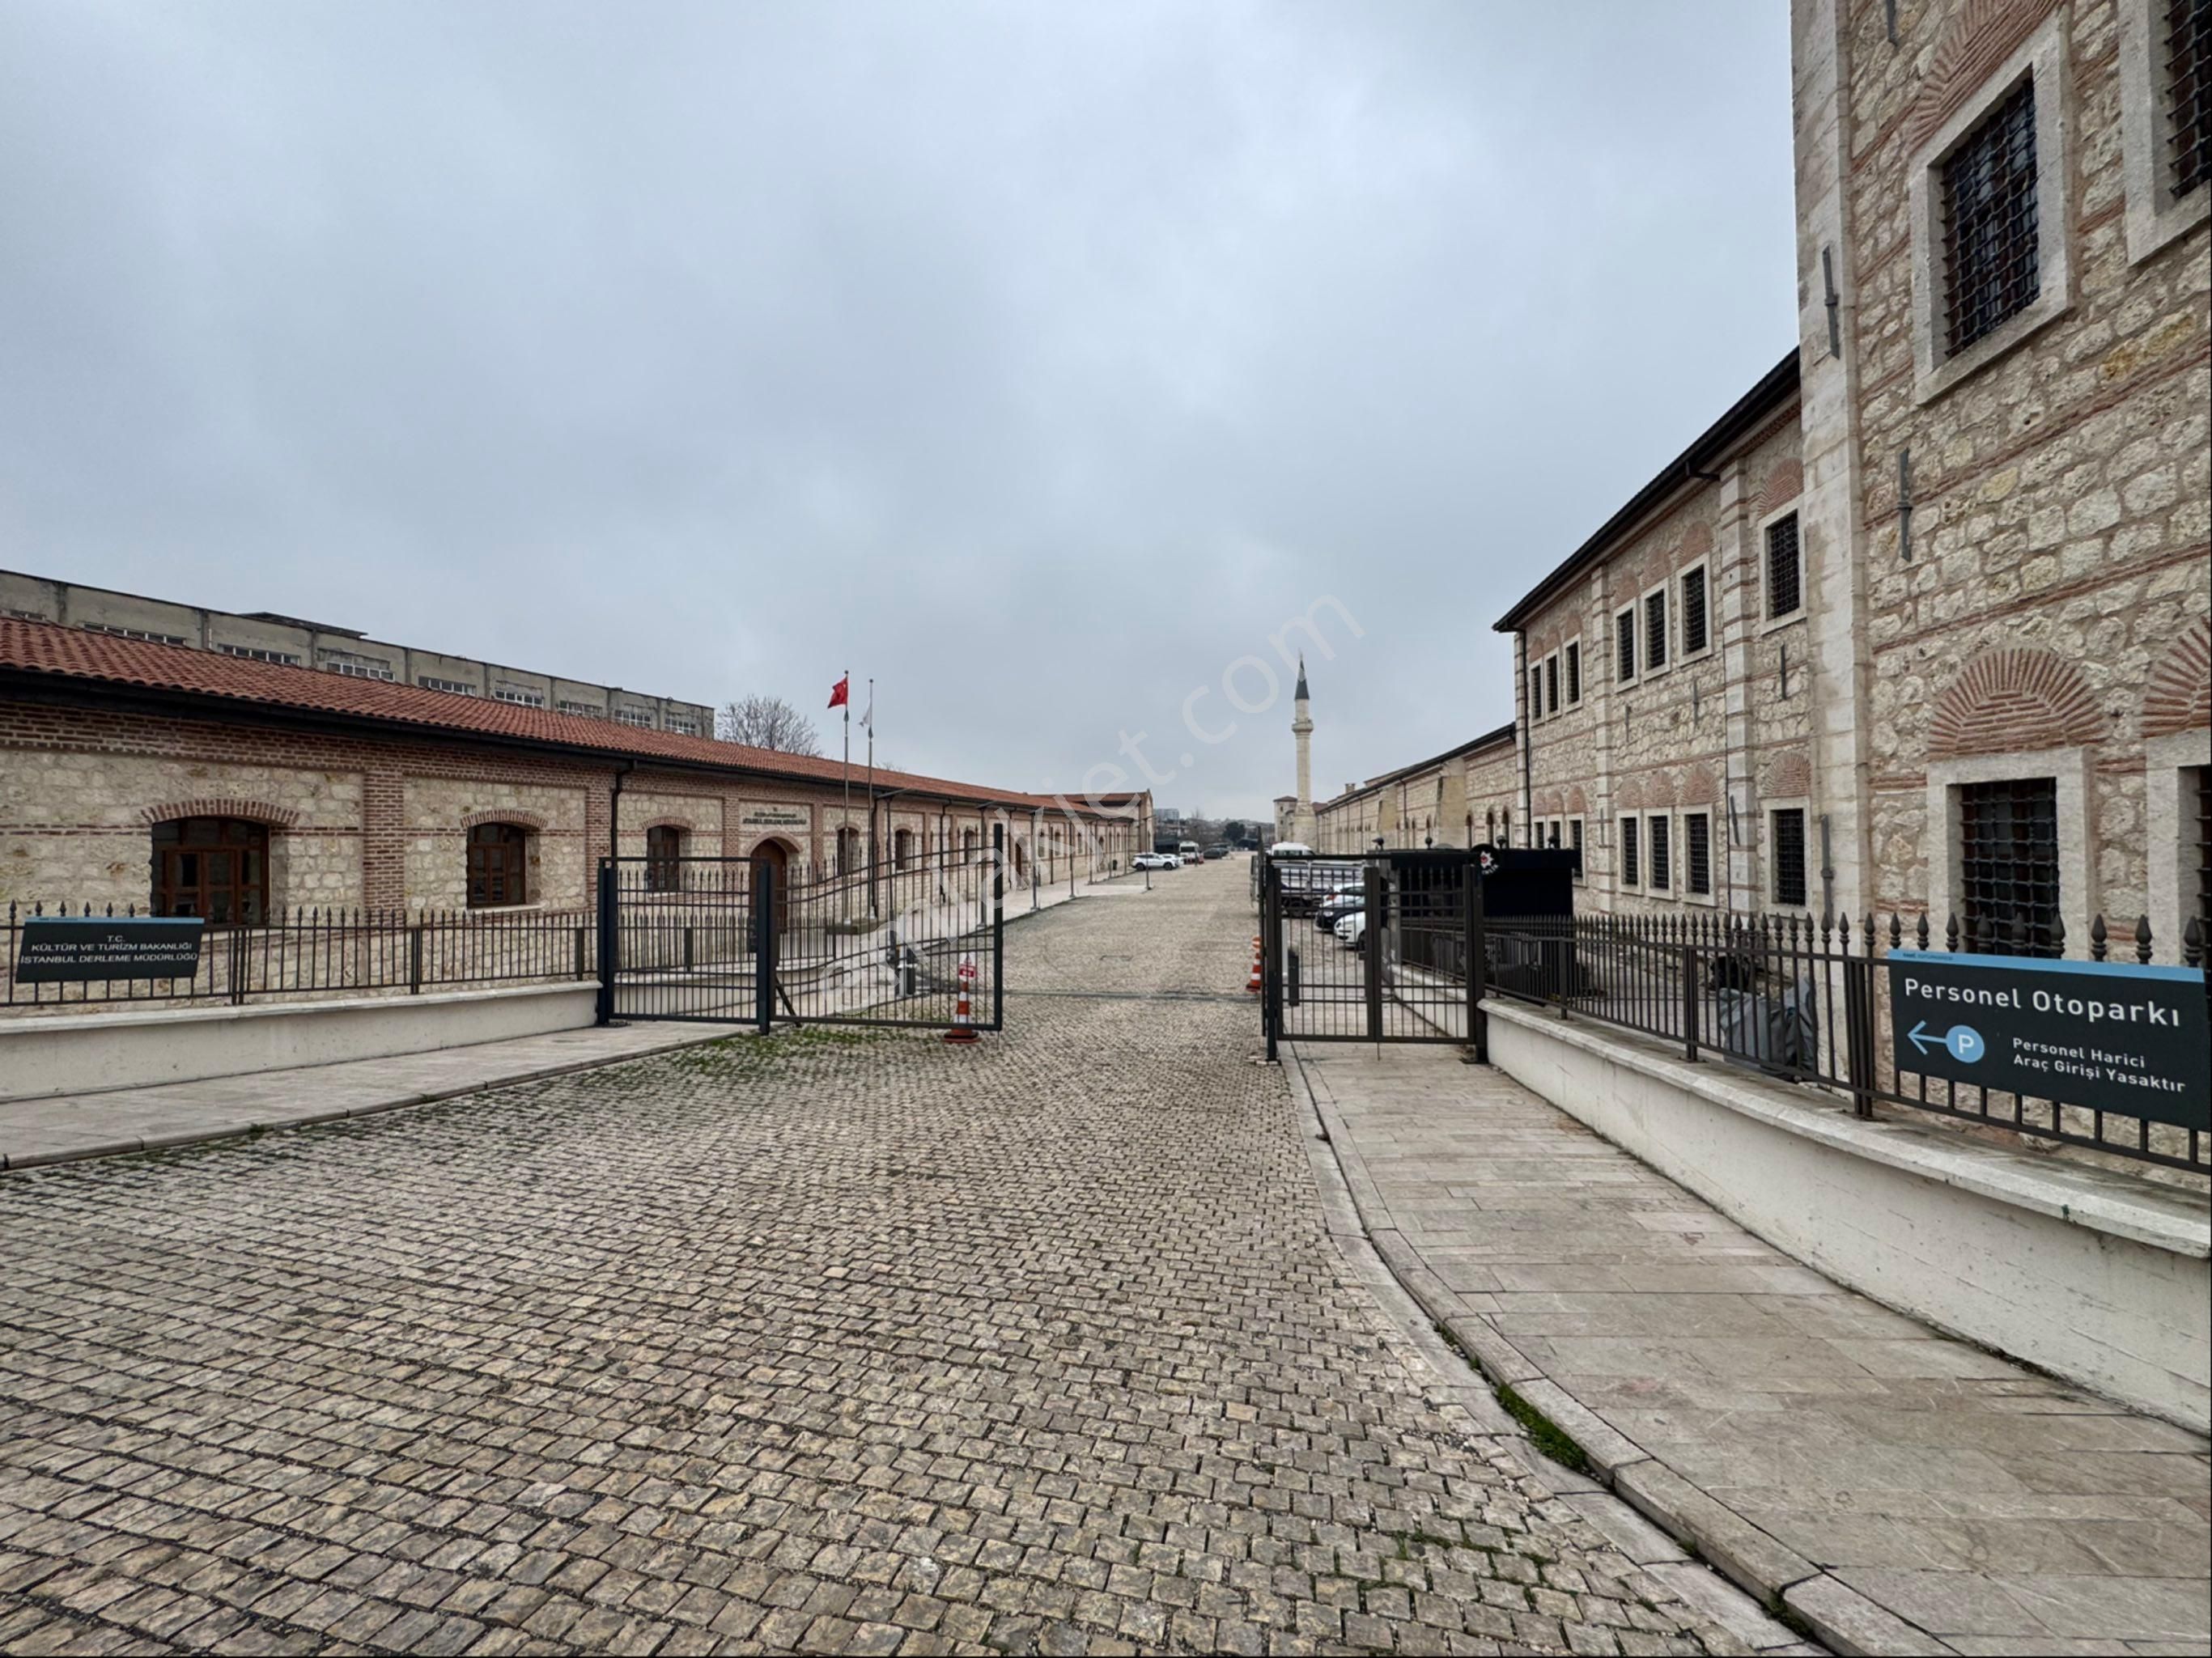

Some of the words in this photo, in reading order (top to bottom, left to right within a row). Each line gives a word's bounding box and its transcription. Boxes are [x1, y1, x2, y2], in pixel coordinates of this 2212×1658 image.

[32, 943, 78, 952] KÜLTÜR
[79, 943, 95, 952] VE
[98, 942, 138, 951] TURİZM
[140, 942, 193, 951] BAKANLIĞI
[107, 935, 125, 943] T.C.
[20, 955, 76, 965] İSTANBUL
[79, 954, 131, 963] DERLEME
[134, 952, 198, 962] MÜDÜRLÜĞÜ
[1904, 977, 2022, 1009] Personel
[2032, 990, 2180, 1027] Otoparkı
[1958, 1034, 1974, 1054] P
[2012, 1037, 2086, 1059] Personel
[2091, 1049, 2146, 1068] Harici
[2014, 1054, 2049, 1072] Araç
[2054, 1061, 2101, 1080] Girişi
[2105, 1068, 2186, 1092] Yasaktır
